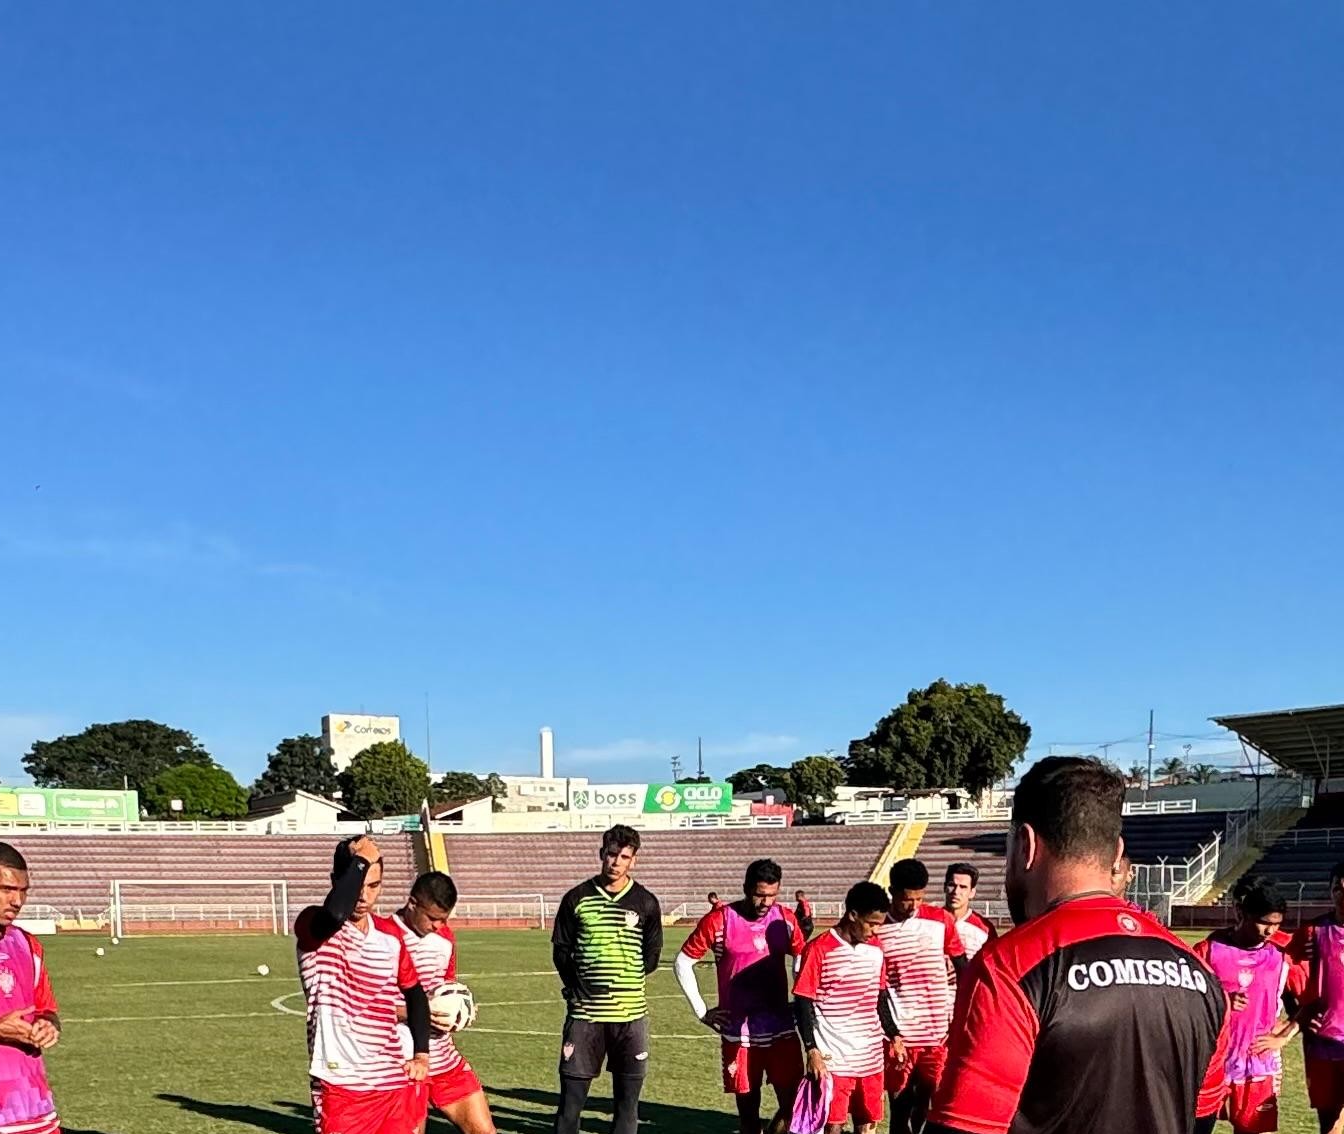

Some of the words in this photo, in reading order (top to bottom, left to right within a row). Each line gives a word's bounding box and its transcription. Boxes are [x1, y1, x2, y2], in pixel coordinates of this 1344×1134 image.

[353, 724, 391, 735] Correios
[594, 790, 637, 805] boss
[1067, 957, 1208, 994] COMISSÃO
